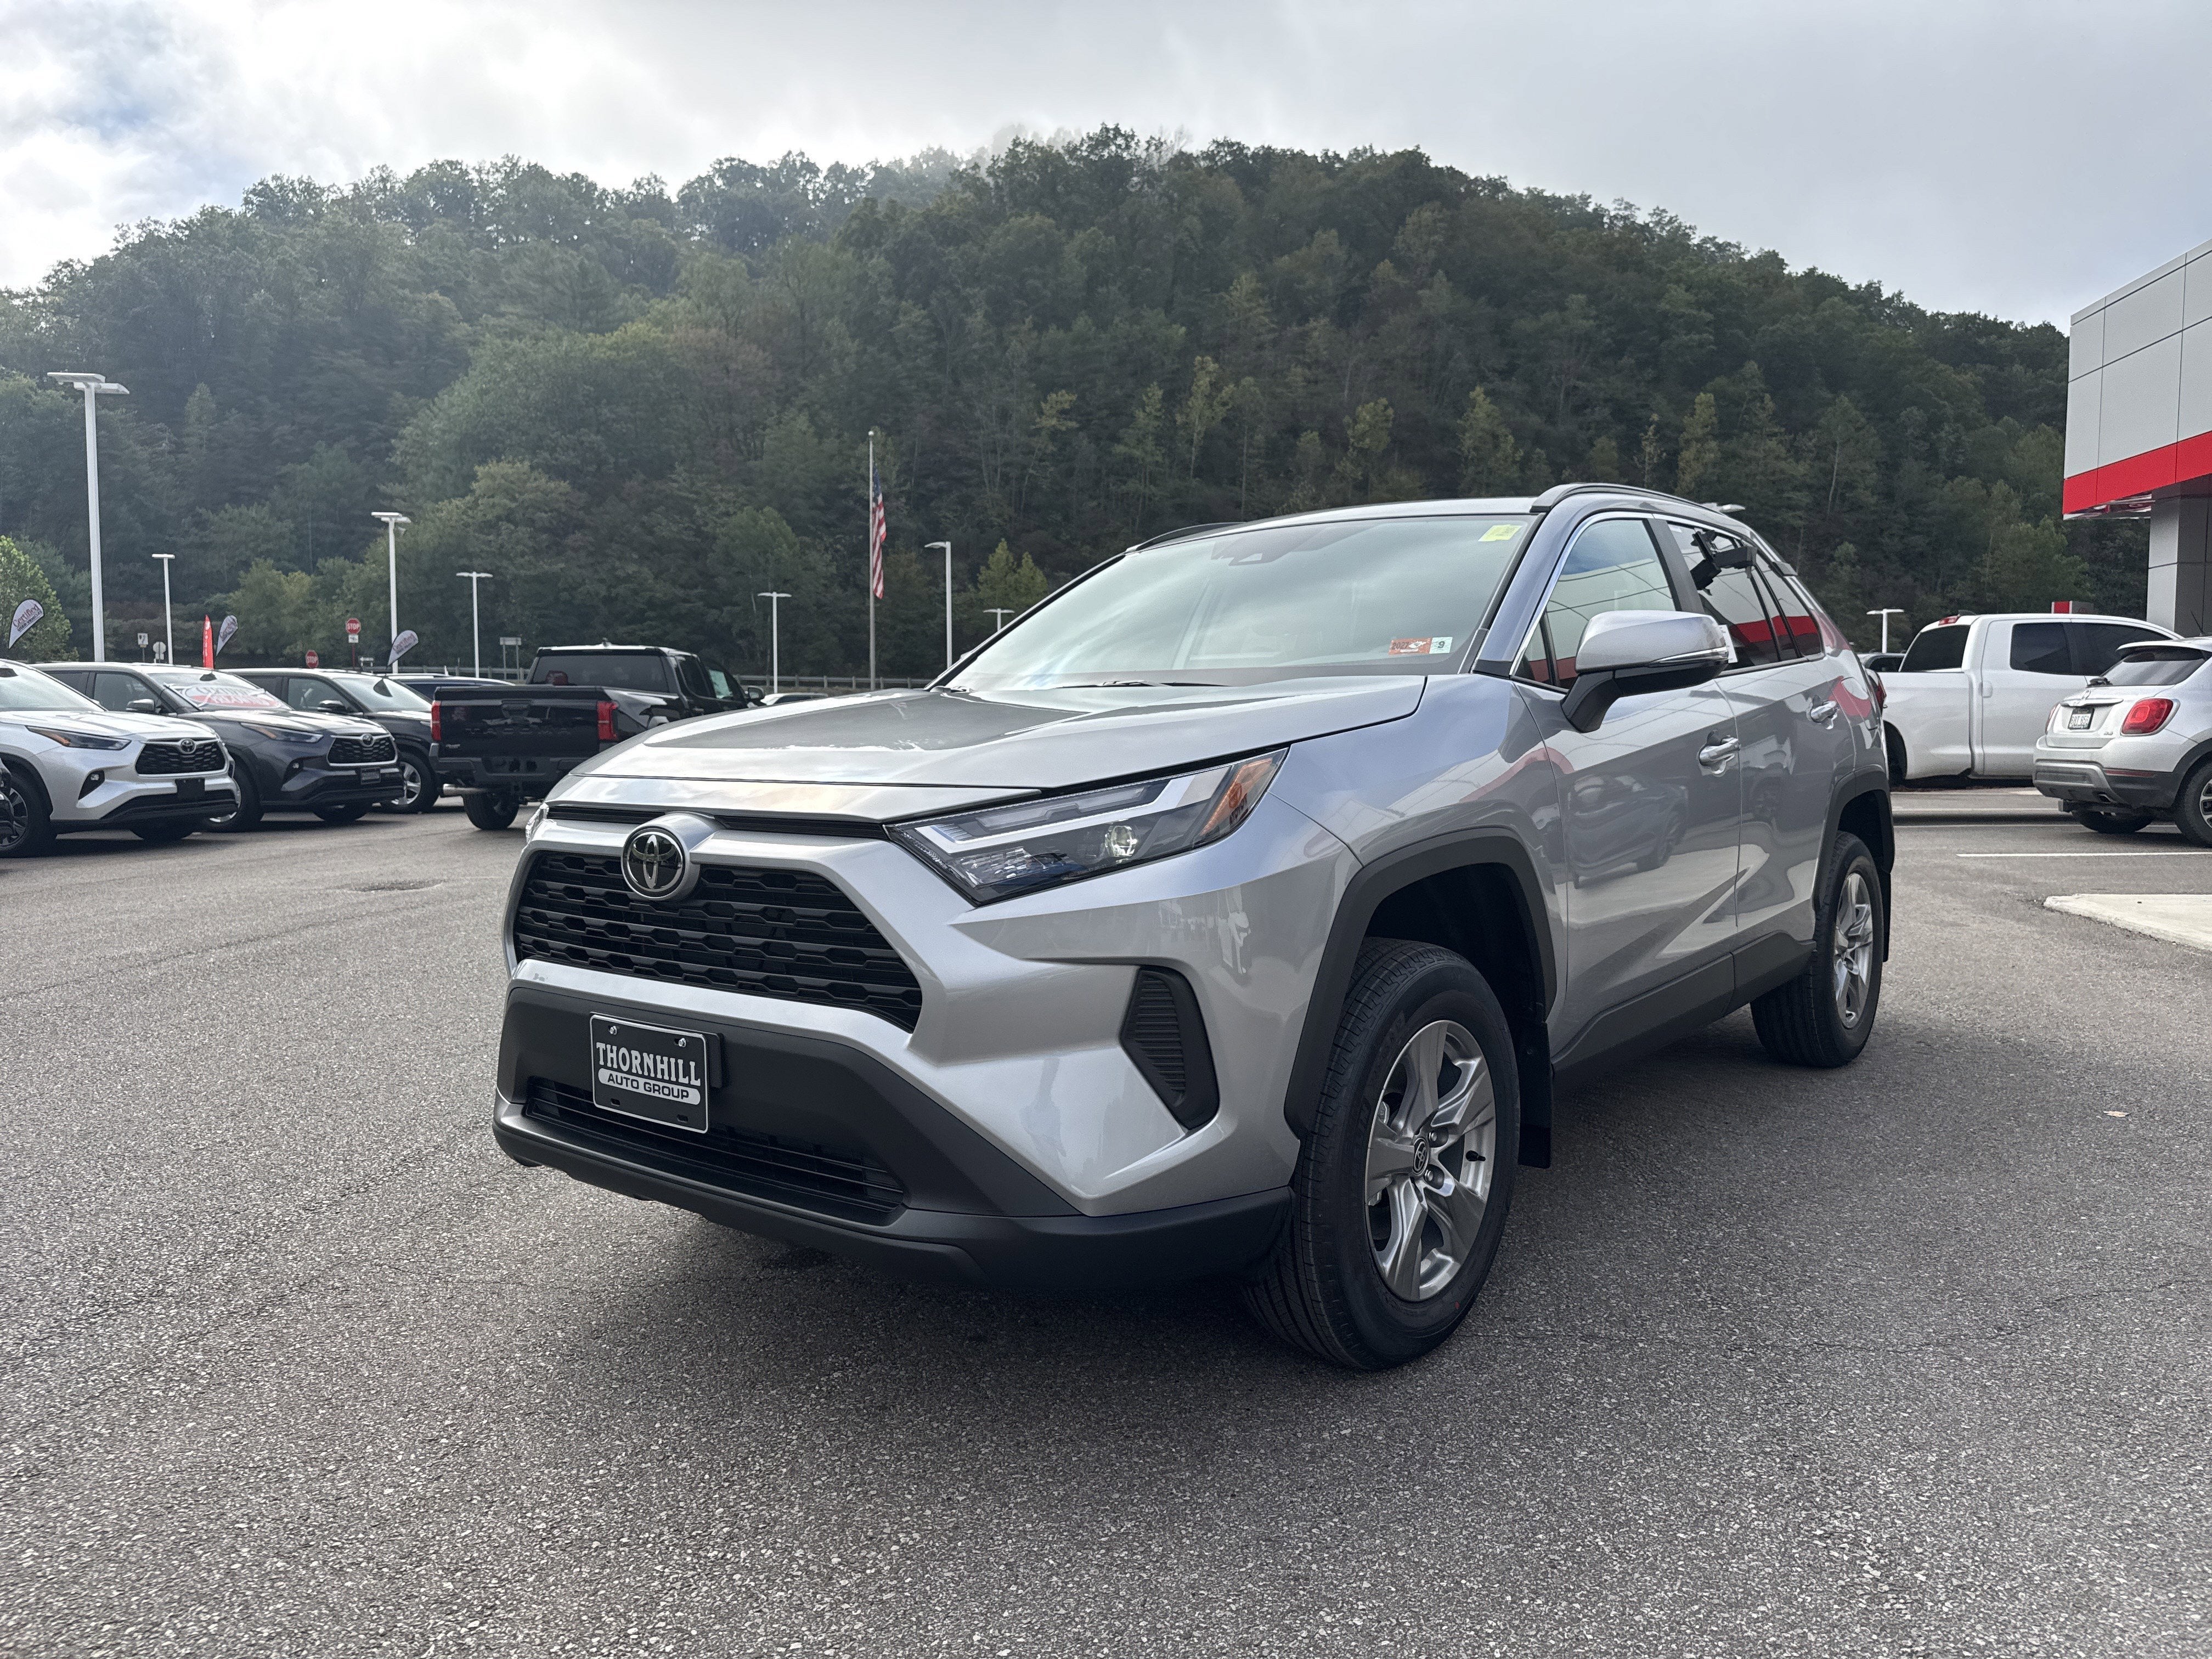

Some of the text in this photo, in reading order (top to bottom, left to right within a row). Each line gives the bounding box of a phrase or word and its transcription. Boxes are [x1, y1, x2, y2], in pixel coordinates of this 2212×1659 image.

[13, 603, 41, 627] Certified
[1391, 641, 1409, 650] 2027
[307, 656, 318, 664] STOP
[596, 1042, 701, 1087] THORNHILL
[607, 1073, 690, 1101] AUTO GROUP
